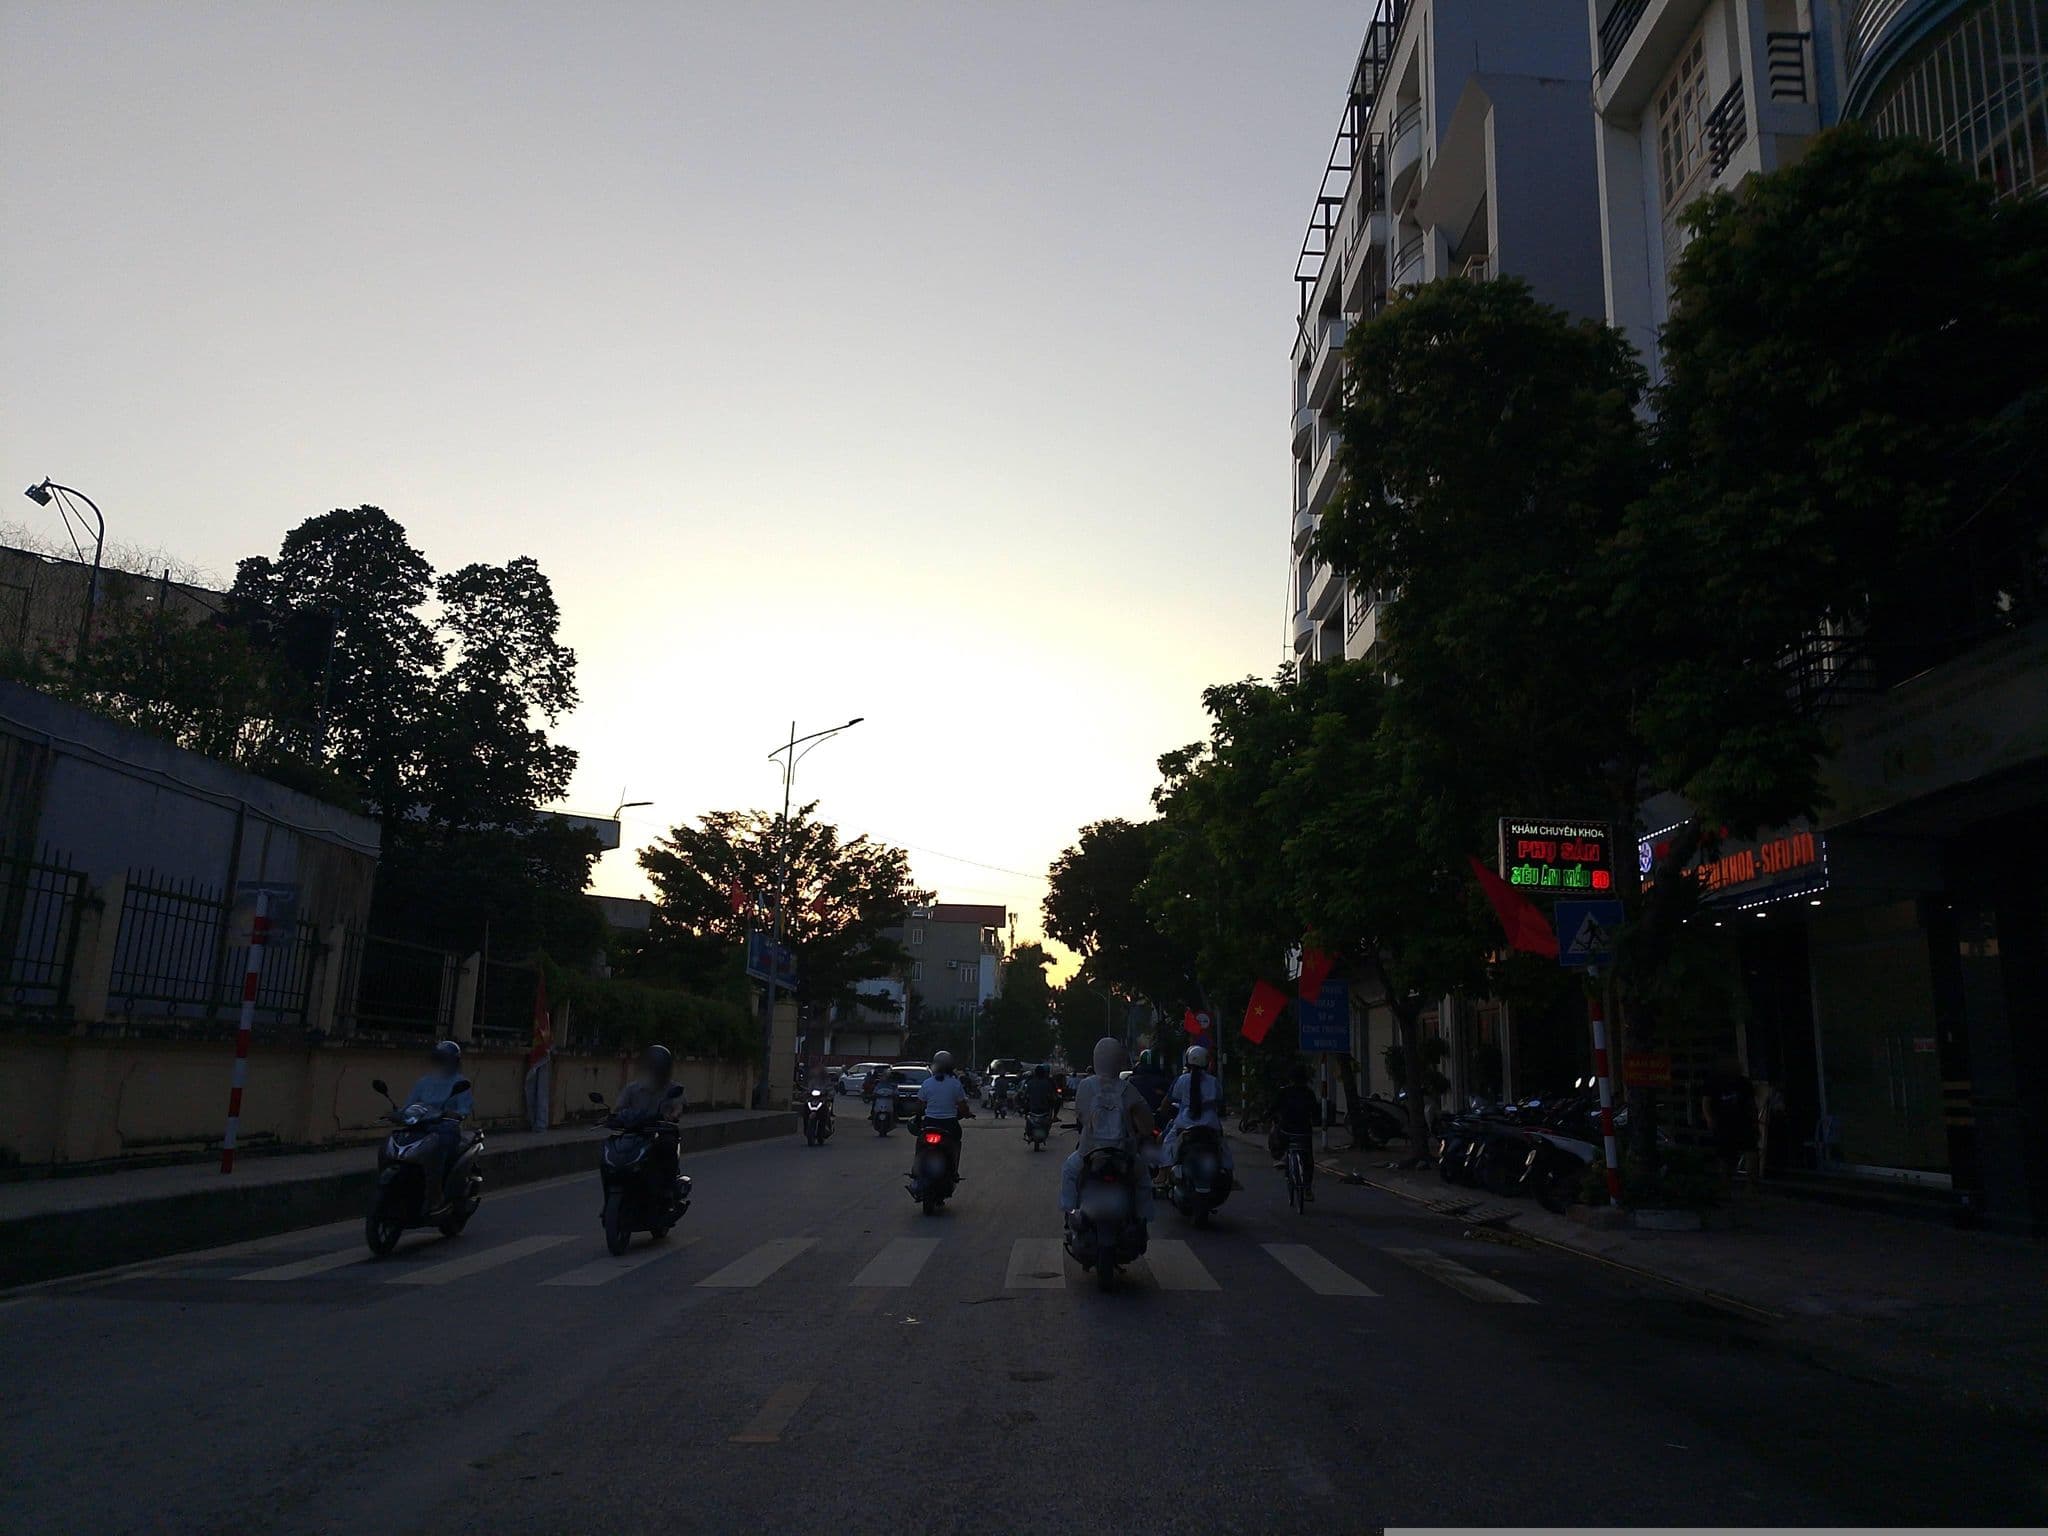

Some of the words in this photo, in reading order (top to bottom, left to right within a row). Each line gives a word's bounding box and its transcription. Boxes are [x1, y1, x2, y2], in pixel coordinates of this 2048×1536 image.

[1511, 823, 1538, 835] KHÁM
[1540, 825, 1577, 837] CHUYÊN
[1578, 828, 1605, 838] KHOA
[1517, 840, 1557, 863] PHỤ
[1560, 836, 1601, 862] SẢN
[1511, 863, 1539, 885] SIÊU
[1540, 864, 1561, 886] ÂM
[1721, 849, 1754, 887] KHOA
